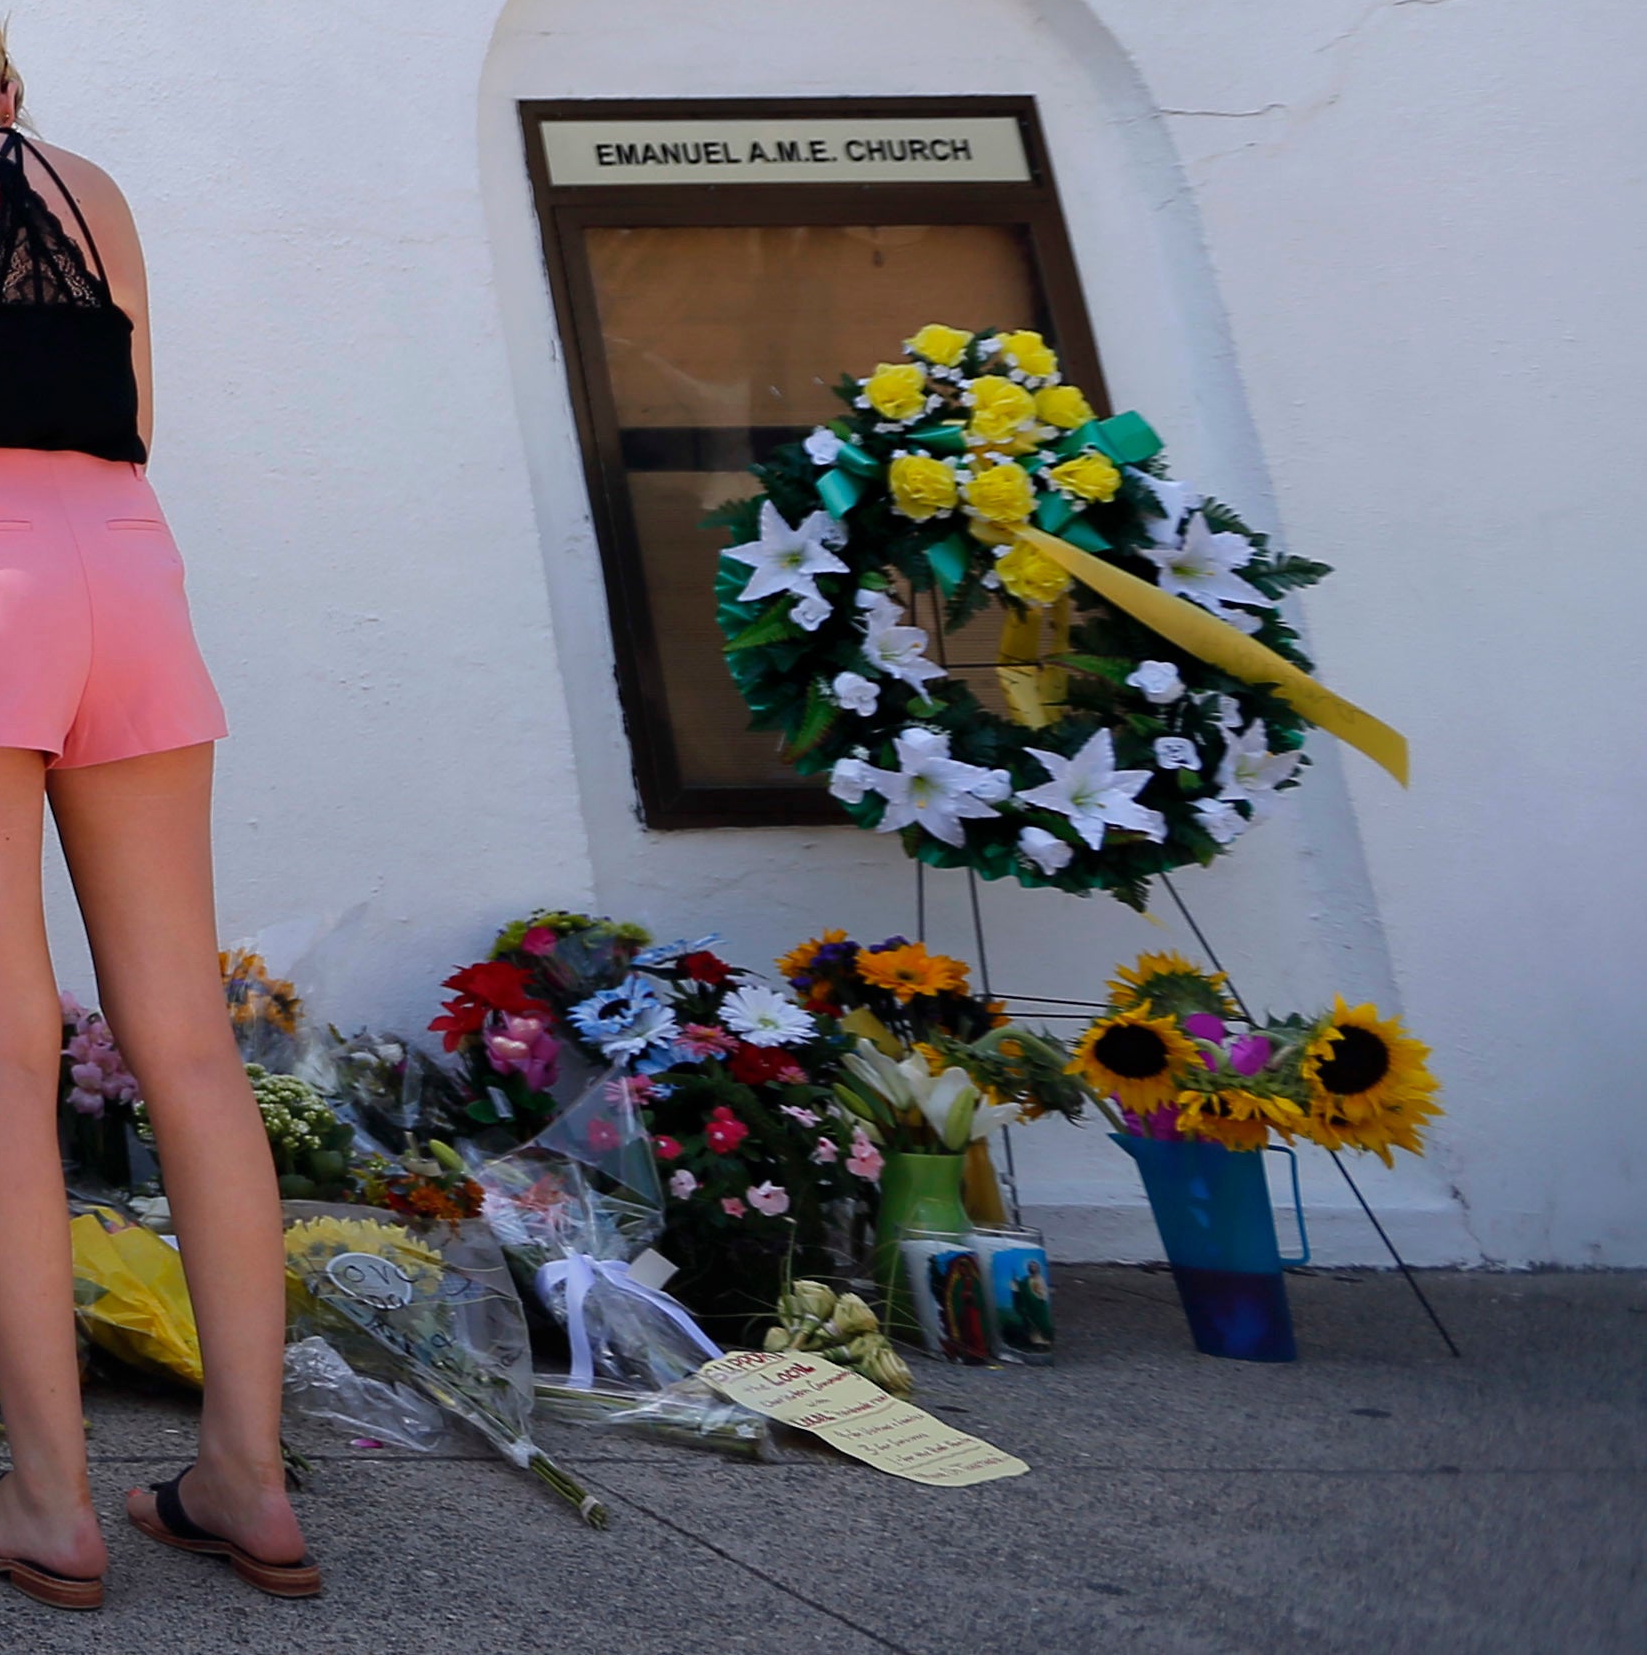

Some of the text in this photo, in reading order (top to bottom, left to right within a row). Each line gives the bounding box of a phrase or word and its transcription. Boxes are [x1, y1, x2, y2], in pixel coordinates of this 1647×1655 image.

[595, 138, 973, 166] EMANUEL A.M.E. CHURCH
